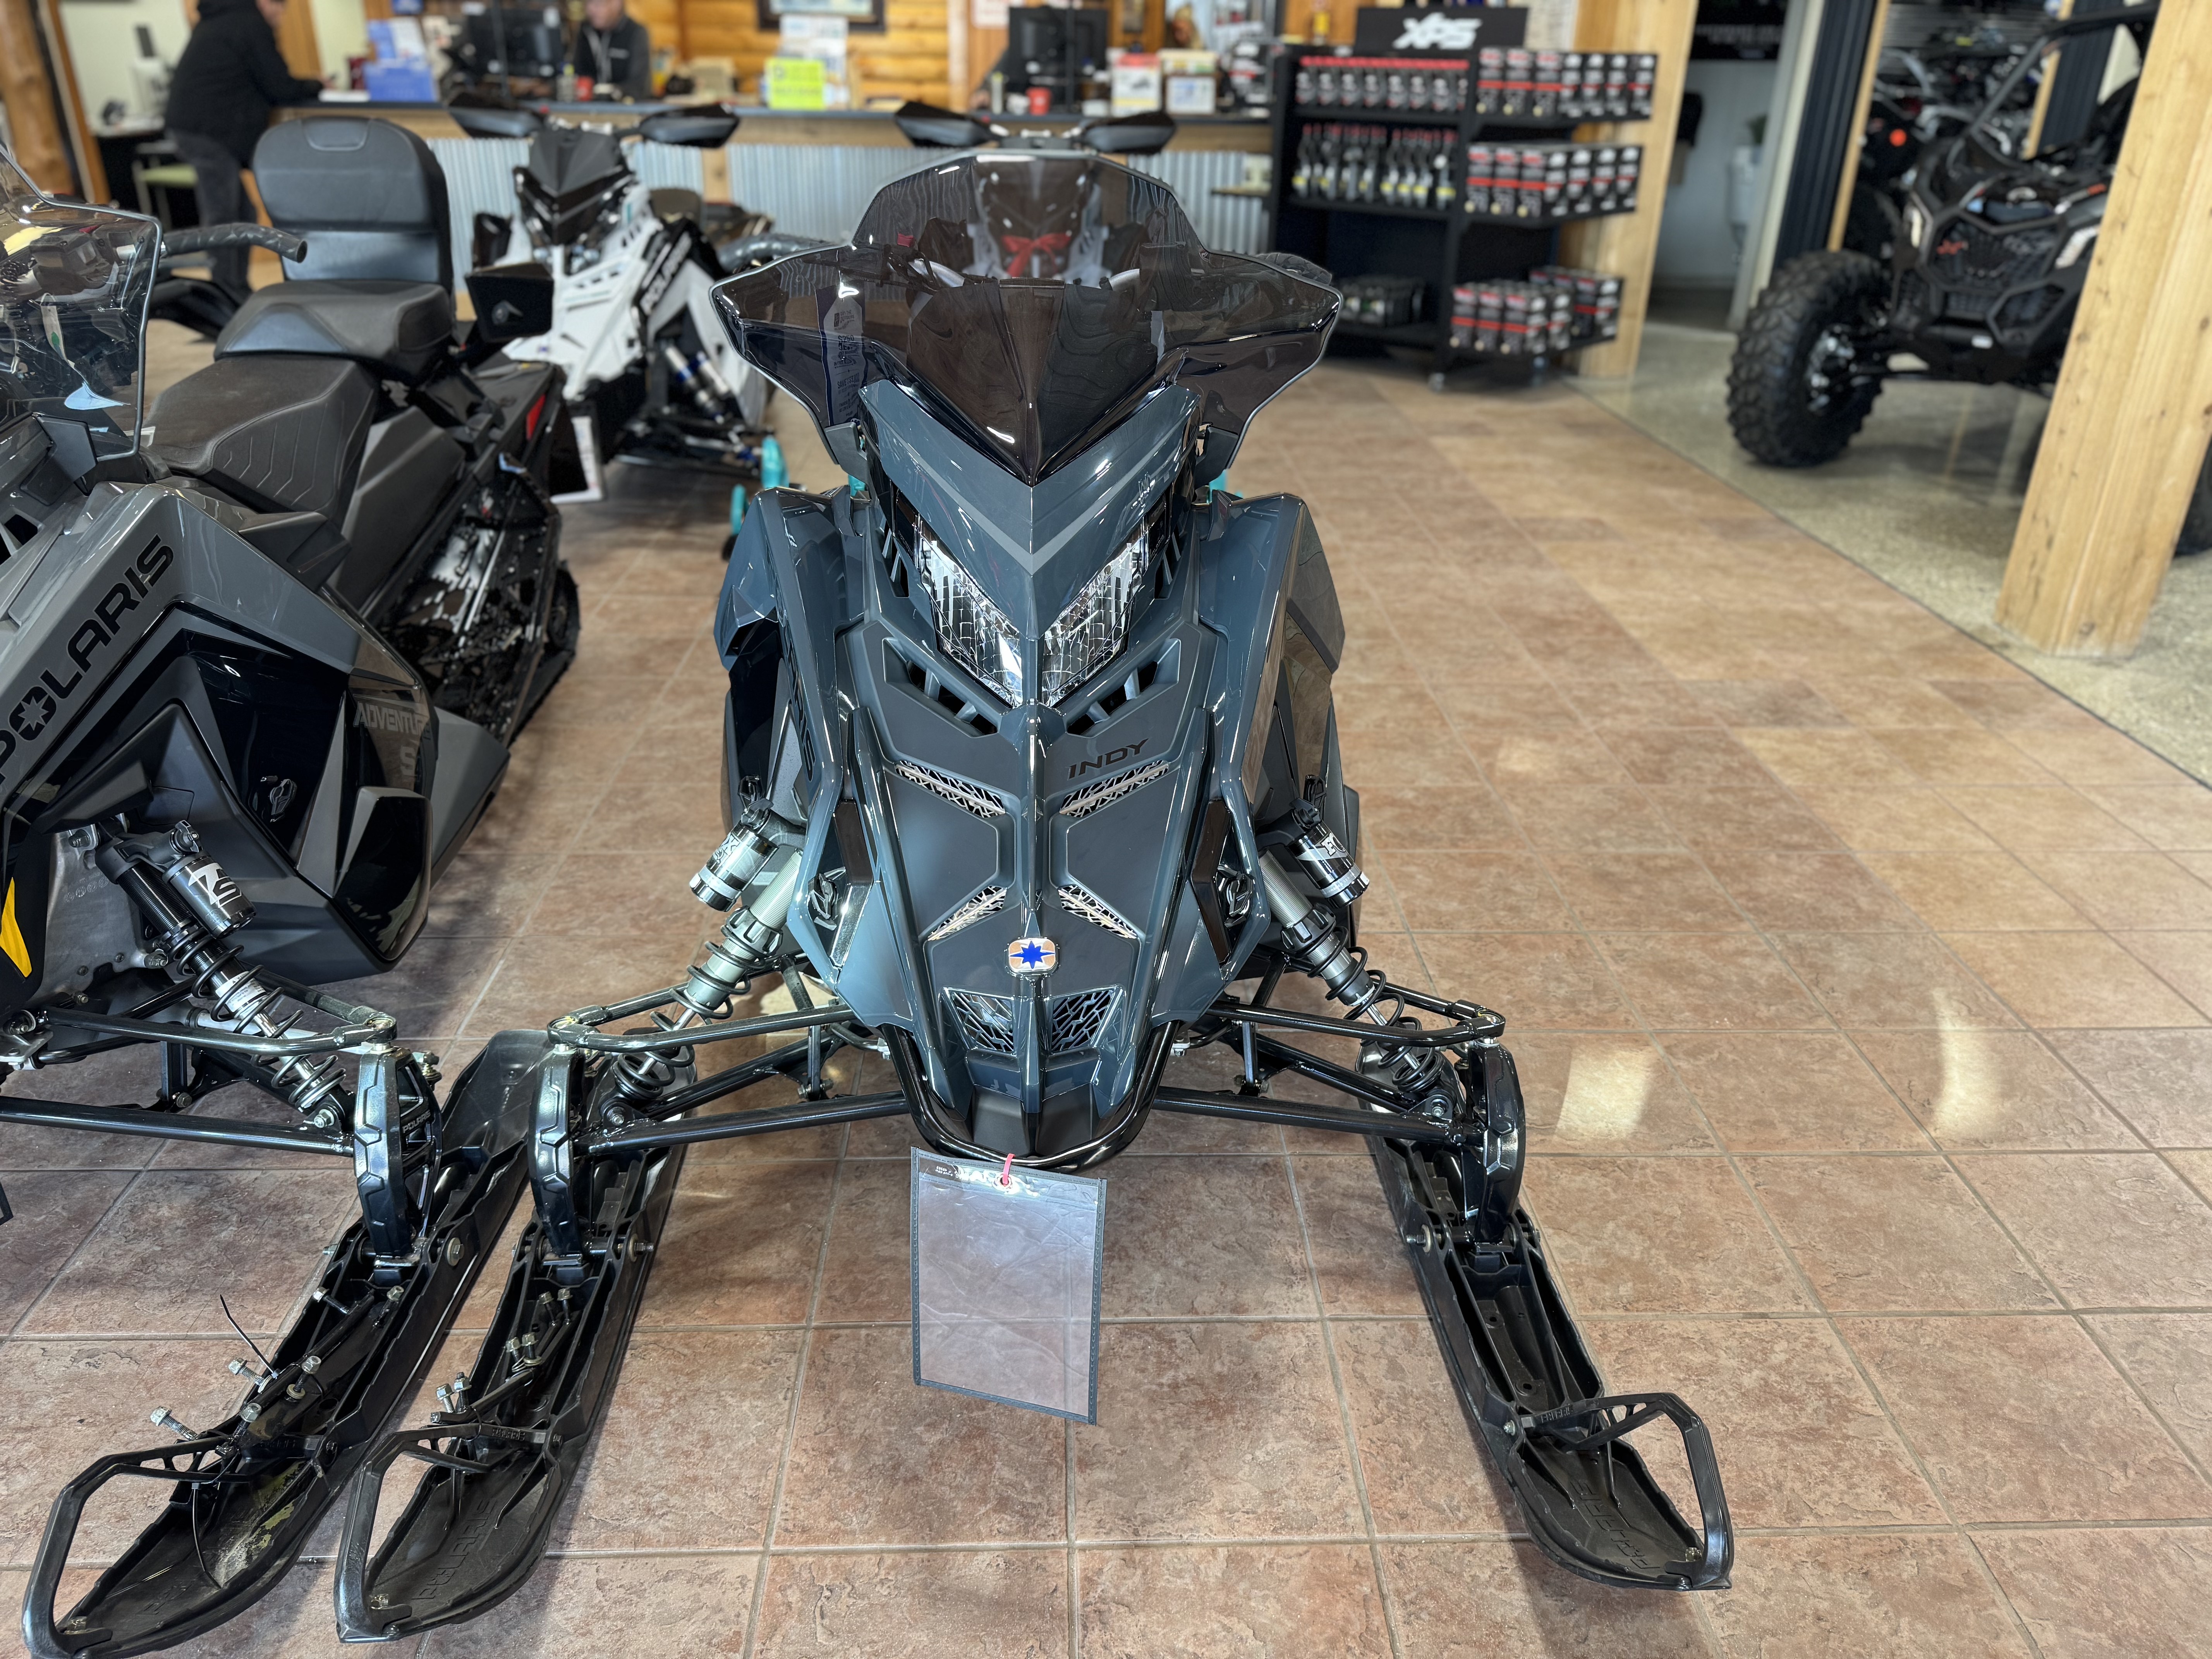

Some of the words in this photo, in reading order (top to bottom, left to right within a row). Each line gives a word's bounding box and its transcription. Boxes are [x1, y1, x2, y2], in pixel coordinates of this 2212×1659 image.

[1392, 12, 1482, 50] XPS
[1067, 738, 1149, 780] INDY
[402, 1109, 431, 1133] POLARIS
[1570, 1480, 1661, 1568] POLARIS
[411, 1499, 498, 1599] POLARIS
